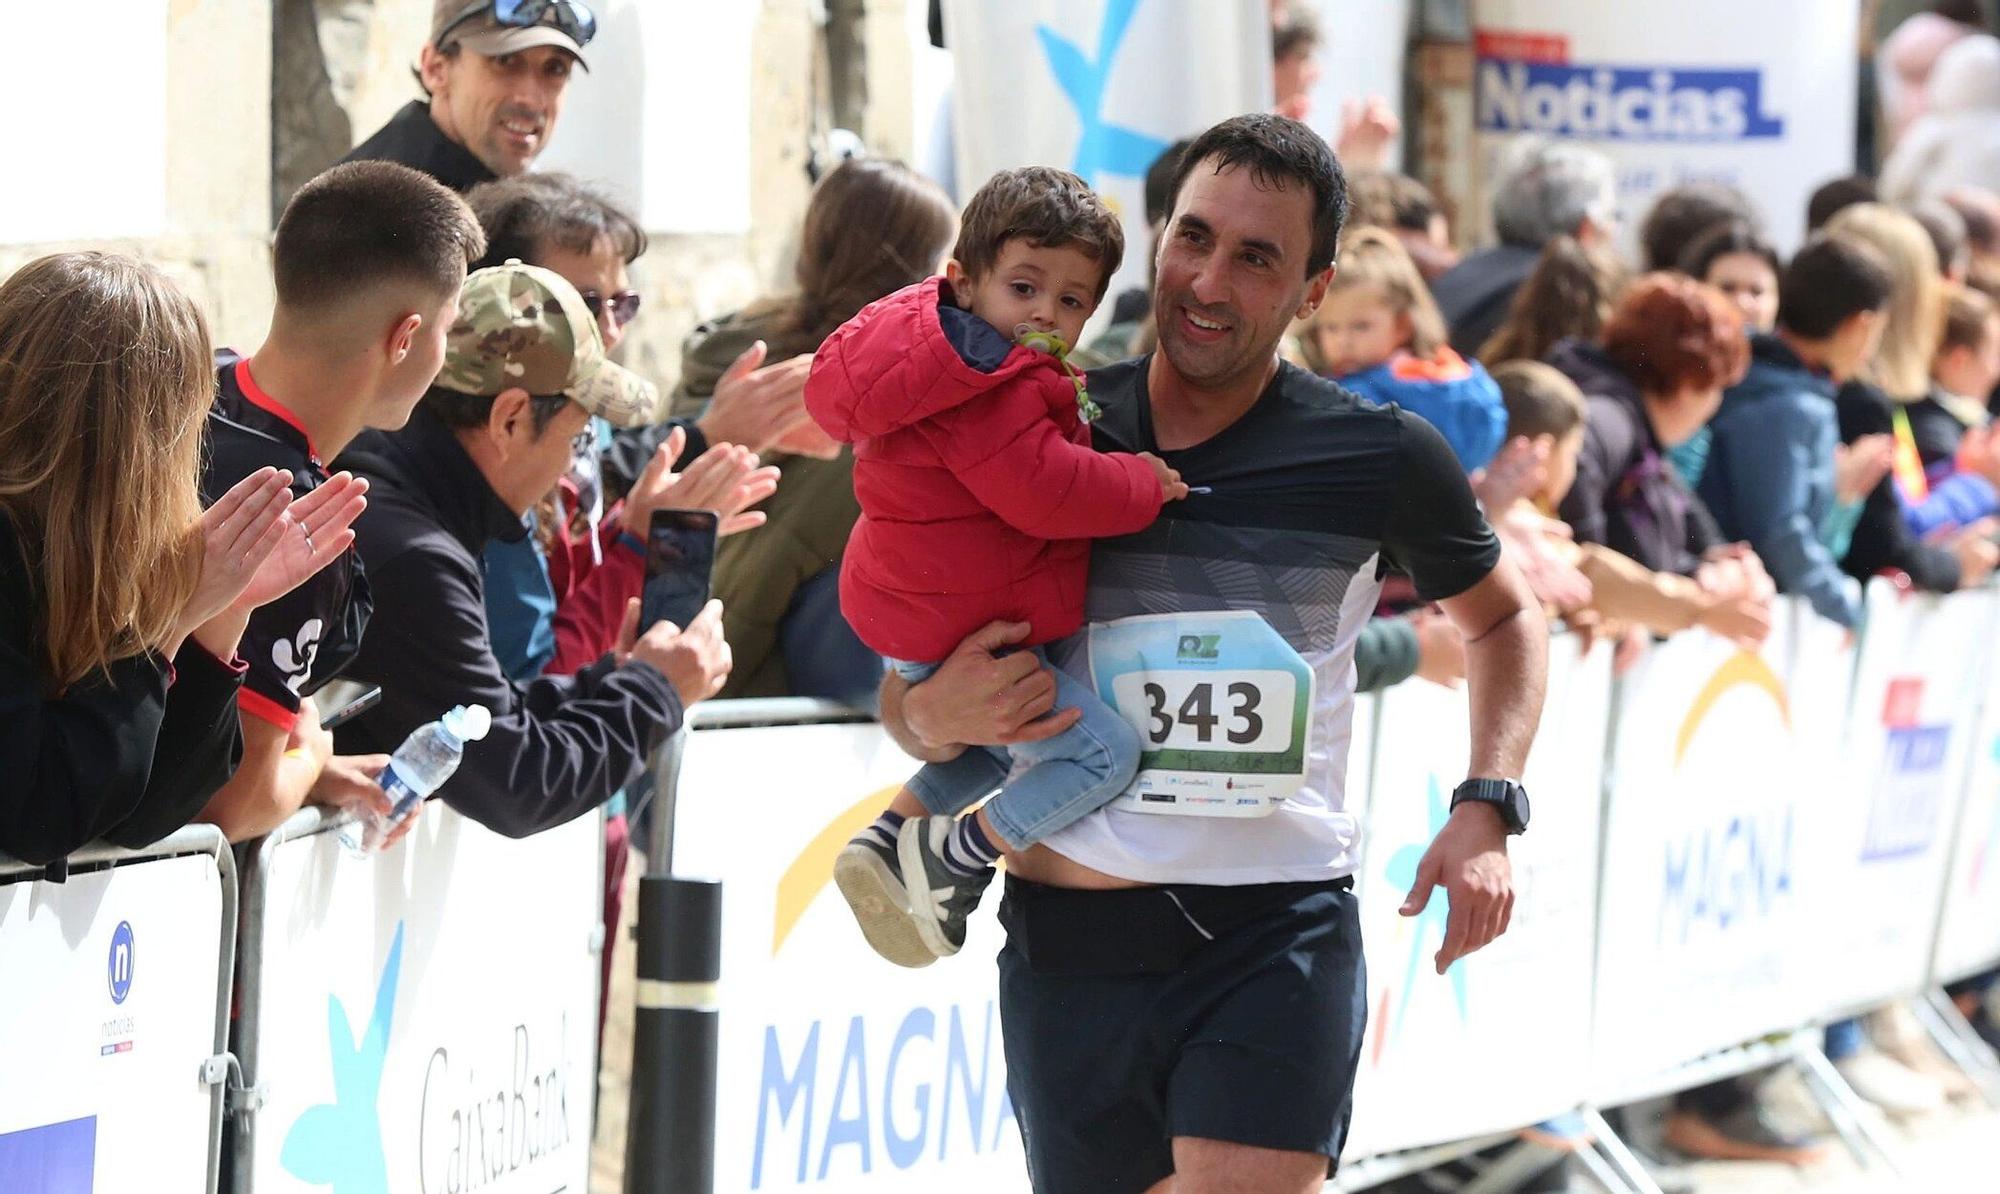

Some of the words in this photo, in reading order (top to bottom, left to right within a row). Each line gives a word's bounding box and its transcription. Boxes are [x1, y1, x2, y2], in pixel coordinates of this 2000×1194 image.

[1478, 62, 1749, 135] Noticias
[1144, 682, 1263, 744] 343
[1656, 802, 1795, 946] MAGNA
